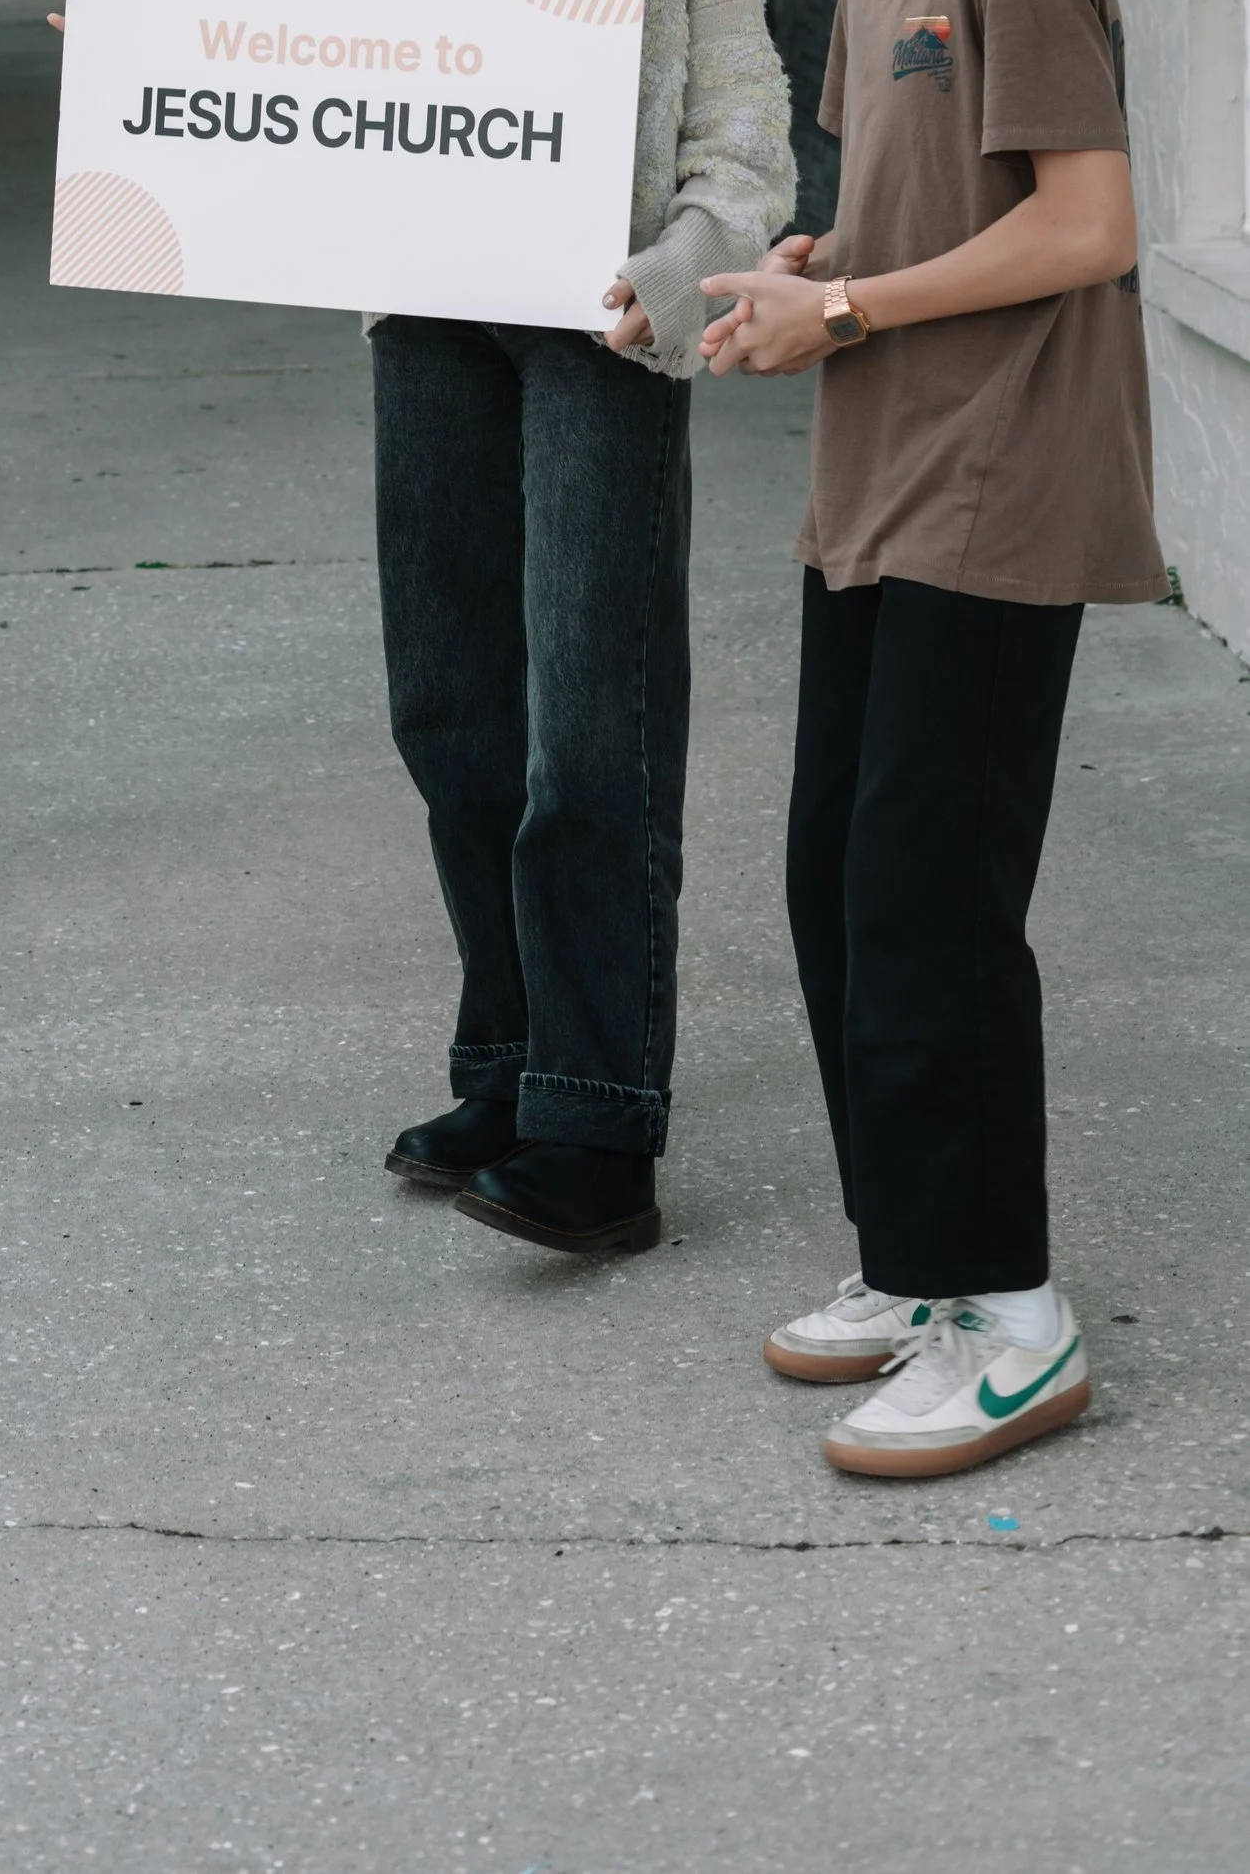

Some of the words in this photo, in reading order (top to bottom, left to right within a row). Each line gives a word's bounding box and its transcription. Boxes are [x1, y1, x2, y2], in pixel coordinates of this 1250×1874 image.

[199, 19, 421, 73] Welcome
[436, 36, 484, 76] to
[122, 86, 299, 145] JESUS
[312, 97, 564, 163] CHURCH
